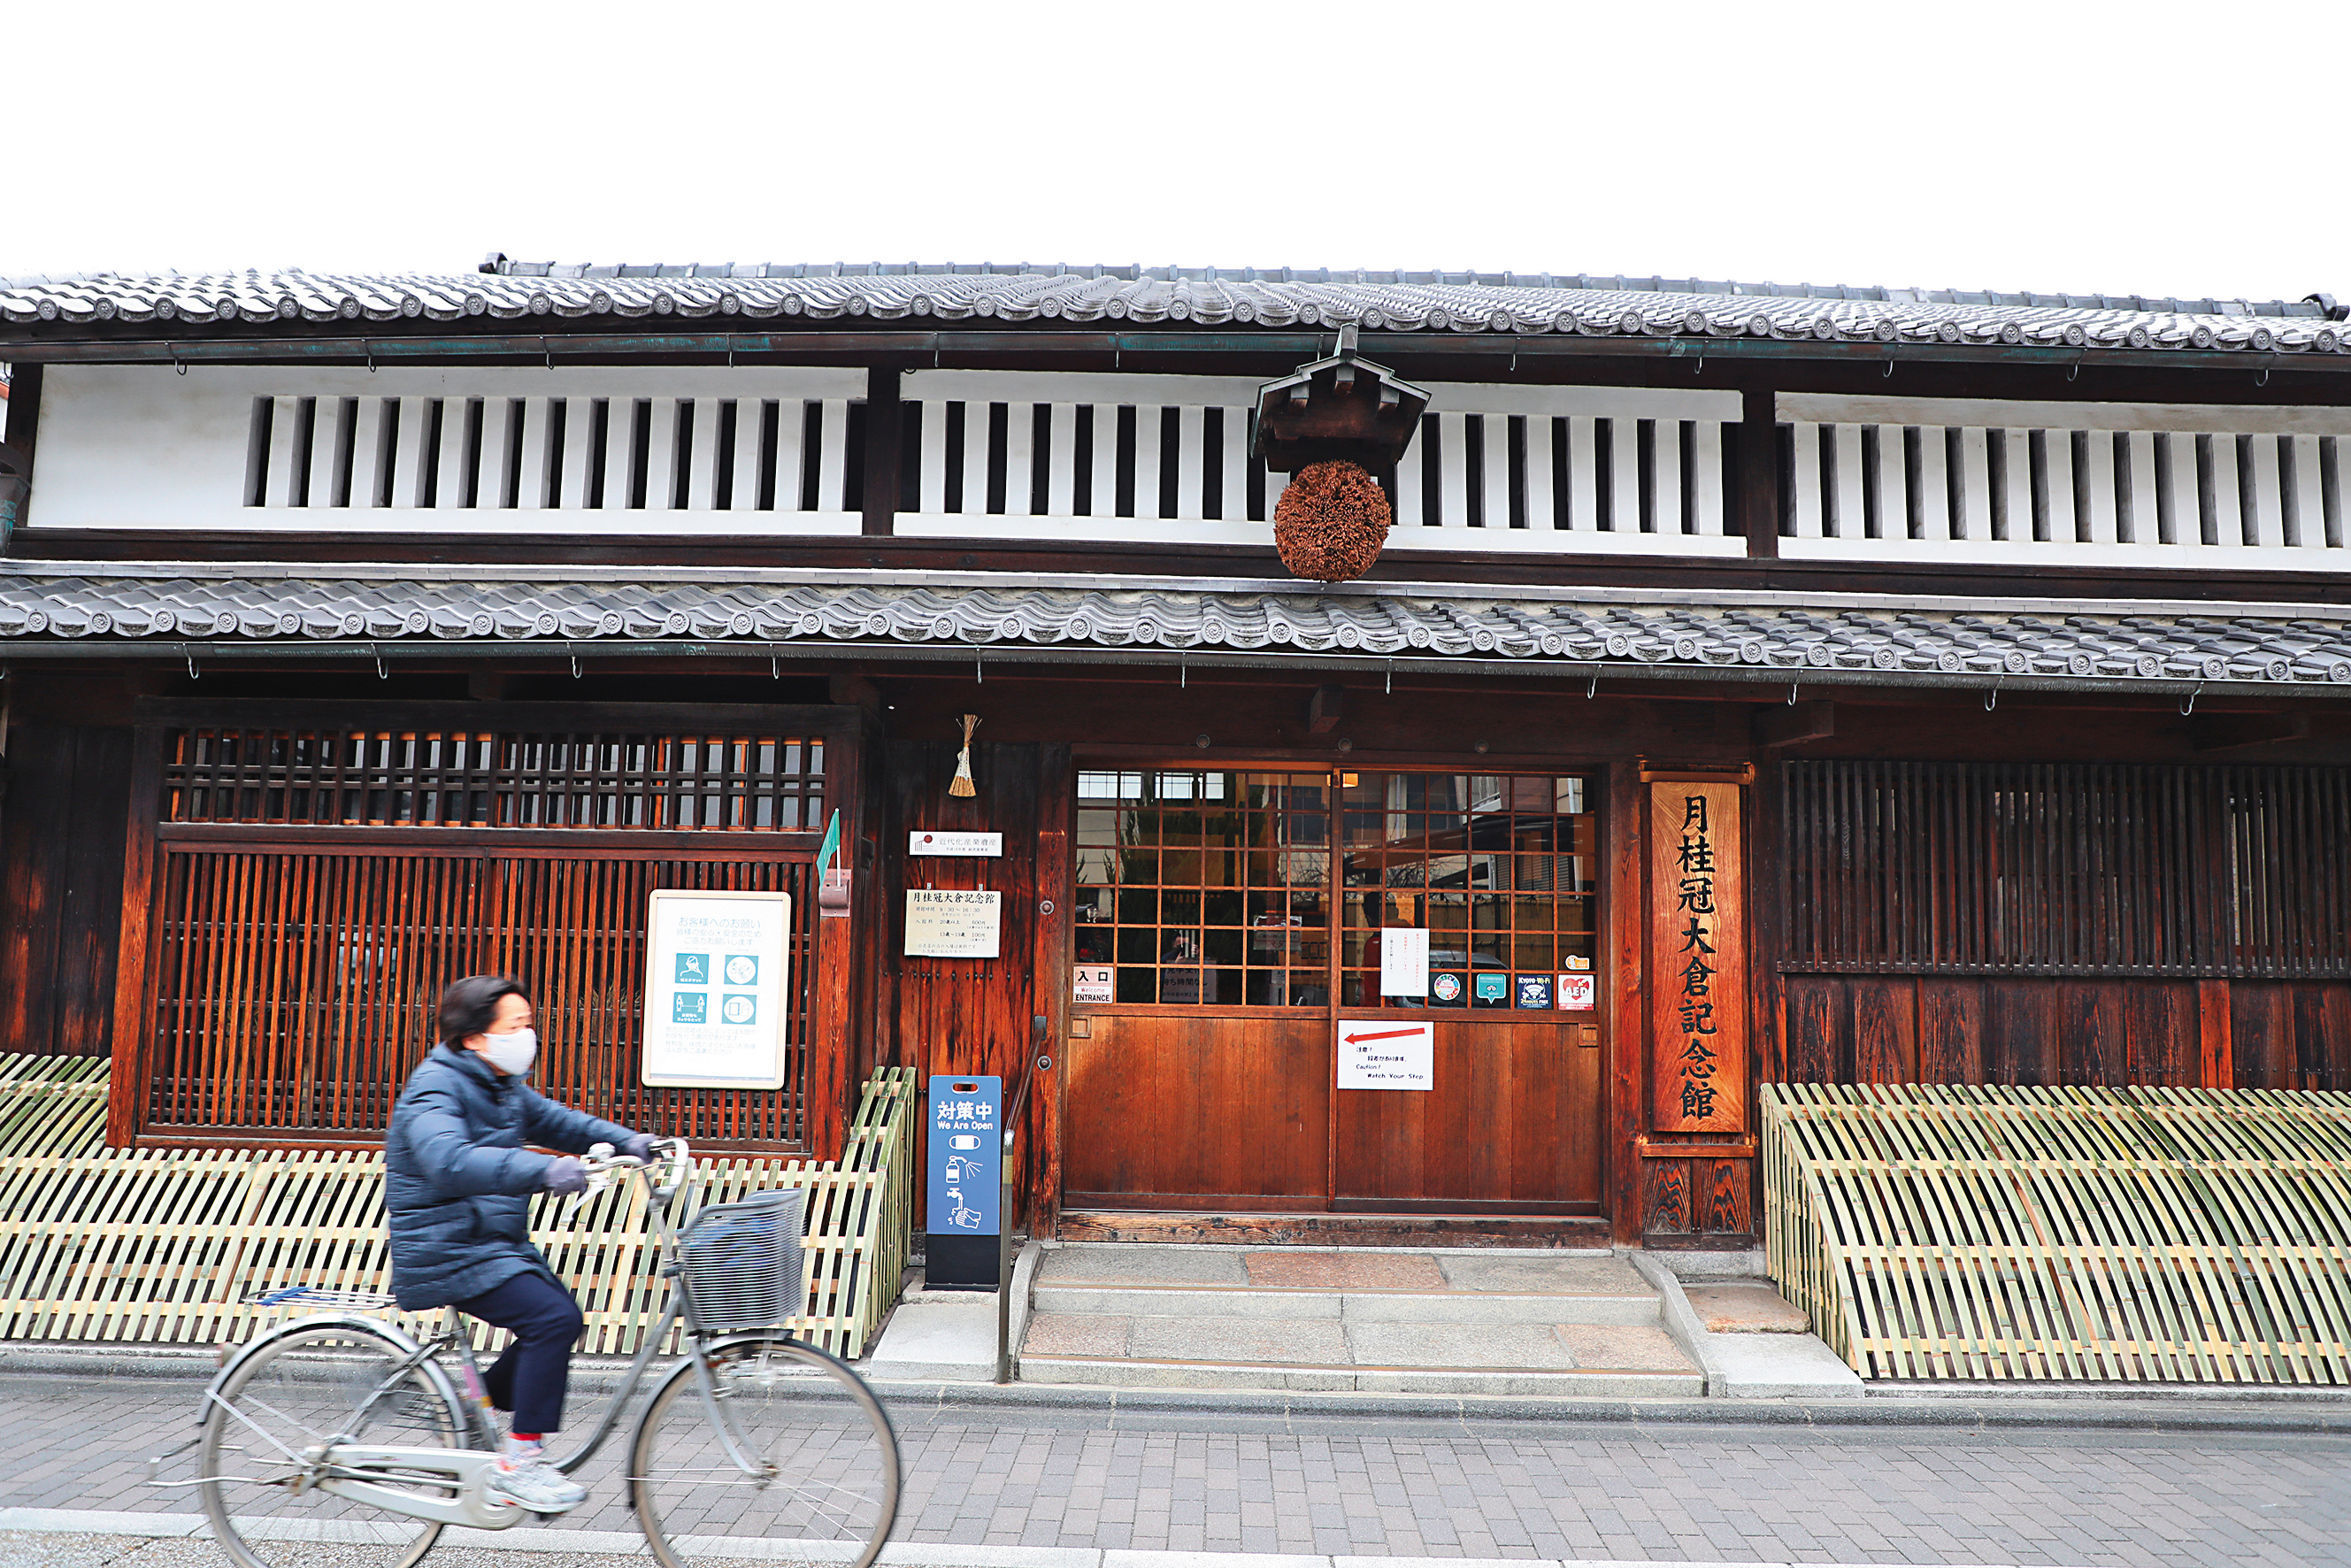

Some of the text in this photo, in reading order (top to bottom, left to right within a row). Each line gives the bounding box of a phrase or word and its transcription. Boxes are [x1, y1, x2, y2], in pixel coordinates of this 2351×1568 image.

[939, 837, 996, 846] 近代化産業遺産
[912, 892, 995, 904] 月桂冠大倉記念館
[678, 917, 761, 929] お客様へのお願い
[676, 927, 762, 938] 皆様の安心・安全のため
[683, 936, 753, 946] ご協力お願いします
[1675, 795, 1717, 1121] 月桂冠大倉記念館
[1078, 970, 1109, 982] 入口
[1563, 986, 1589, 997] AED
[936, 1100, 993, 1120] 対策中
[937, 1120, 994, 1132] We Are Open
